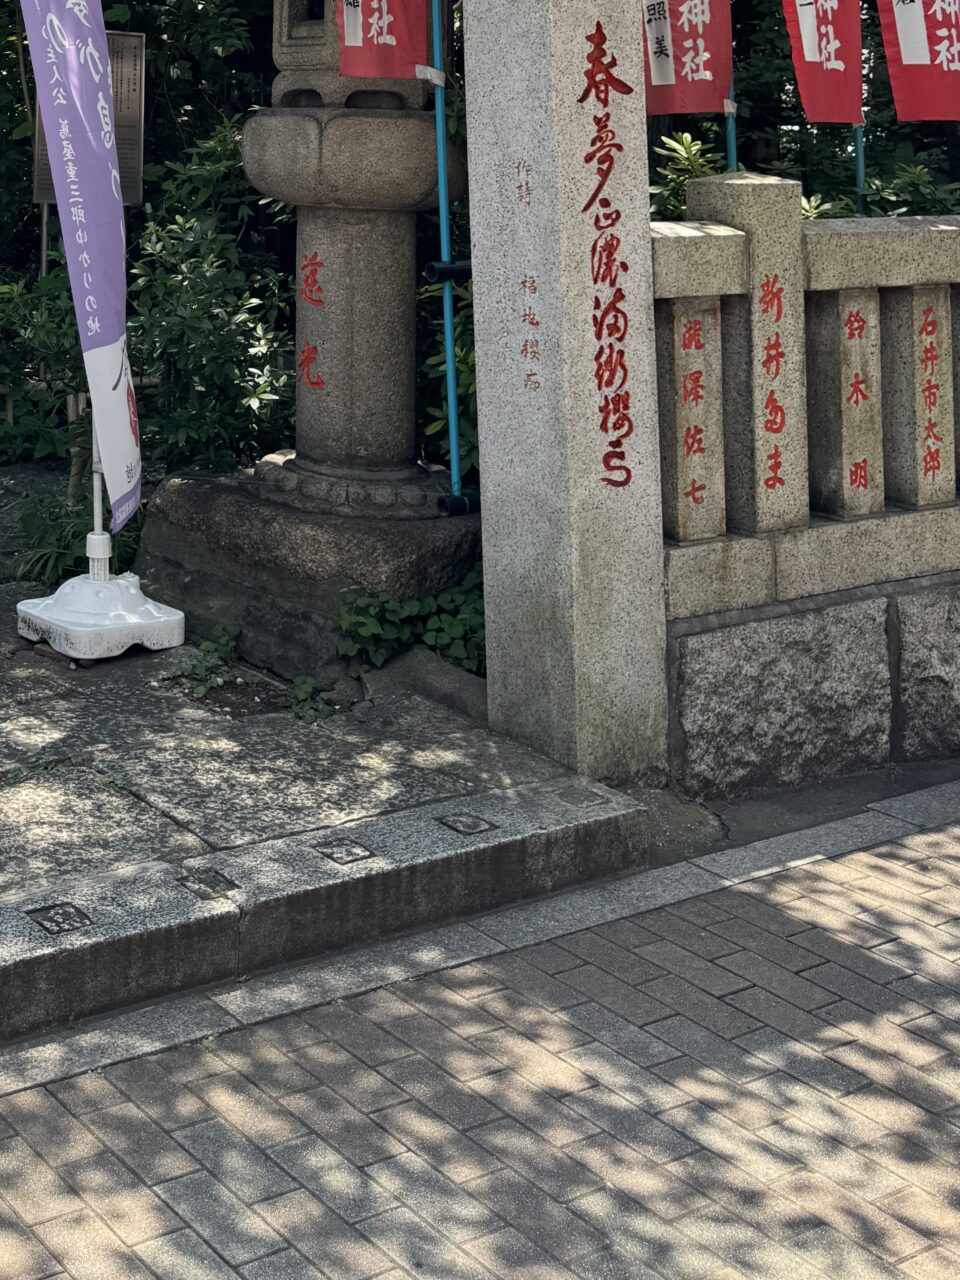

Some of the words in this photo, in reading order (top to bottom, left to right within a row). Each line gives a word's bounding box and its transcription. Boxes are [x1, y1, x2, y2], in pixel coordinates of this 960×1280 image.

[917, 306, 944, 483] 石井市太郎
